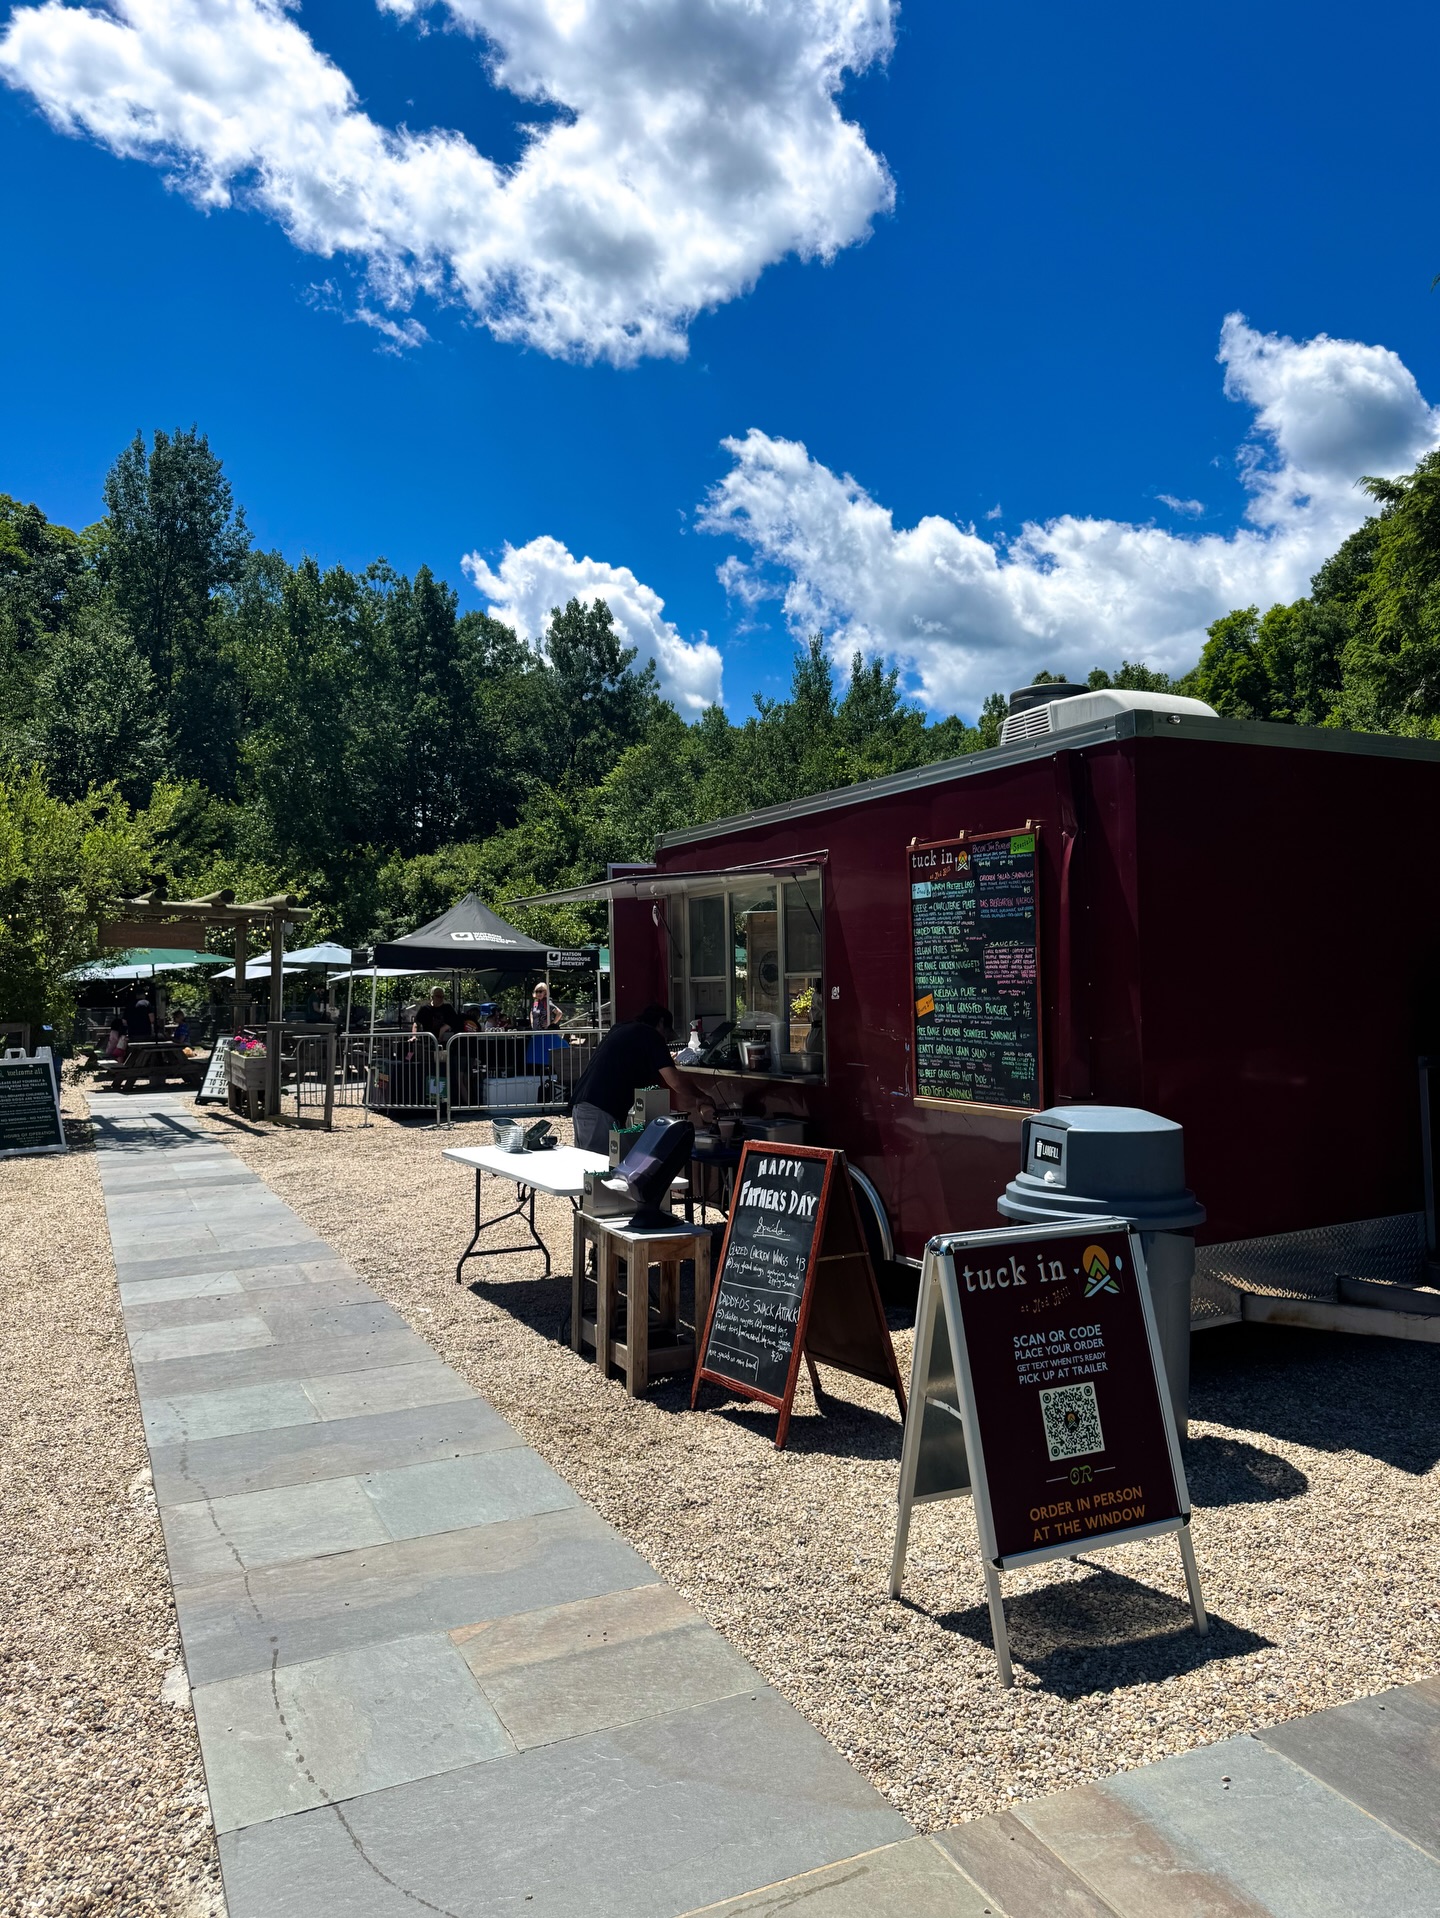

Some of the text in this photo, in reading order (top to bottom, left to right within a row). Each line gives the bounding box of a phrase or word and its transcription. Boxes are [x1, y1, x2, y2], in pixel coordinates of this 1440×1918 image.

[911, 849, 937, 868] tuck
[941, 848, 953, 865] in
[985, 1002, 1009, 1016] BURGER
[7, 1067, 43, 1077] welcome all
[924, 1068, 937, 1078] BEEF
[974, 1072, 987, 1085] DOG
[931, 1085, 946, 1097] TOFU
[757, 1158, 802, 1178] HAPPY
[739, 1179, 817, 1216] FATHER'S DAY
[772, 1248, 789, 1268] WINGS
[795, 1254, 806, 1272] $13
[962, 1253, 1067, 1292] tuck in
[1052, 1286, 1071, 1306] Hill
[1013, 1324, 1103, 1348] SCAN QR CODE
[770, 1349, 784, 1363] $20
[1014, 1338, 1105, 1360] PLACE YOUR ORDER
[1016, 1351, 1106, 1373] GET TEXT WHEN IT'S READY
[1018, 1361, 1109, 1385] PICK UP AT TRAILER
[1069, 1464, 1093, 1486] OR
[1029, 1485, 1143, 1522] ORDER IN PERSON
[1033, 1504, 1146, 1542] AT THE WINDOW
